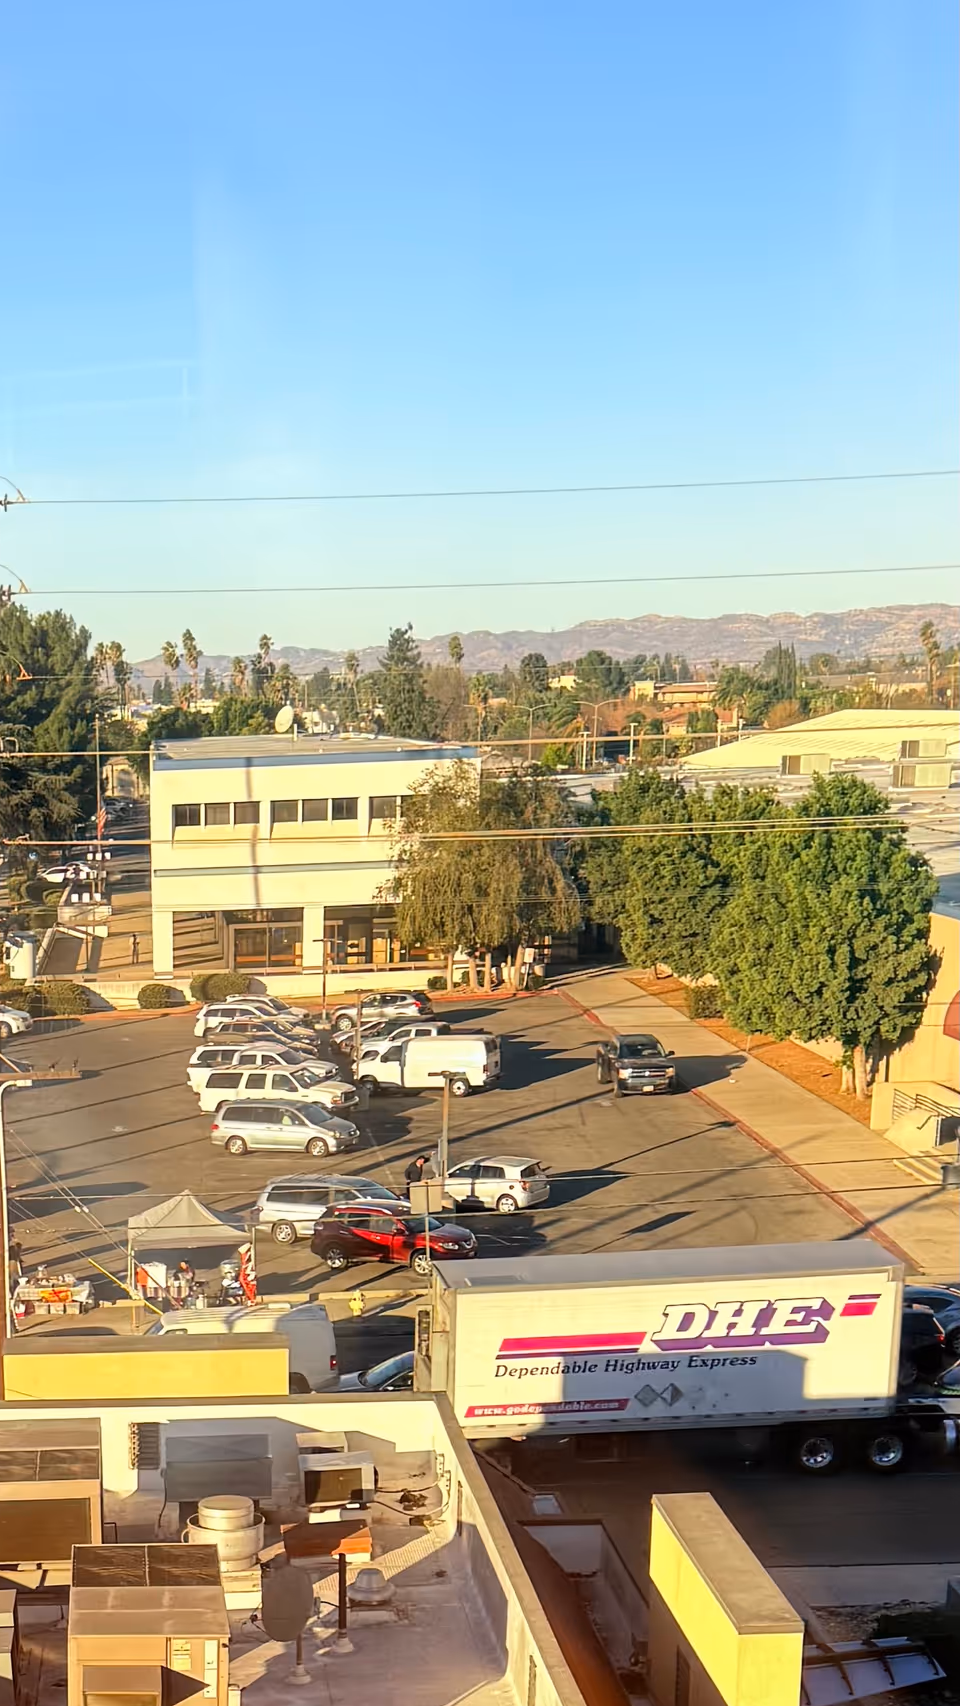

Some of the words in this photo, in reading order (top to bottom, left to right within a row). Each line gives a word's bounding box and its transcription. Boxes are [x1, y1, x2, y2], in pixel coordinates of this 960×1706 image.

[651, 1297, 833, 1347] DHE
[494, 1361, 597, 1379] Dependable
[604, 1356, 681, 1375] Highway
[687, 1352, 758, 1370] Express
